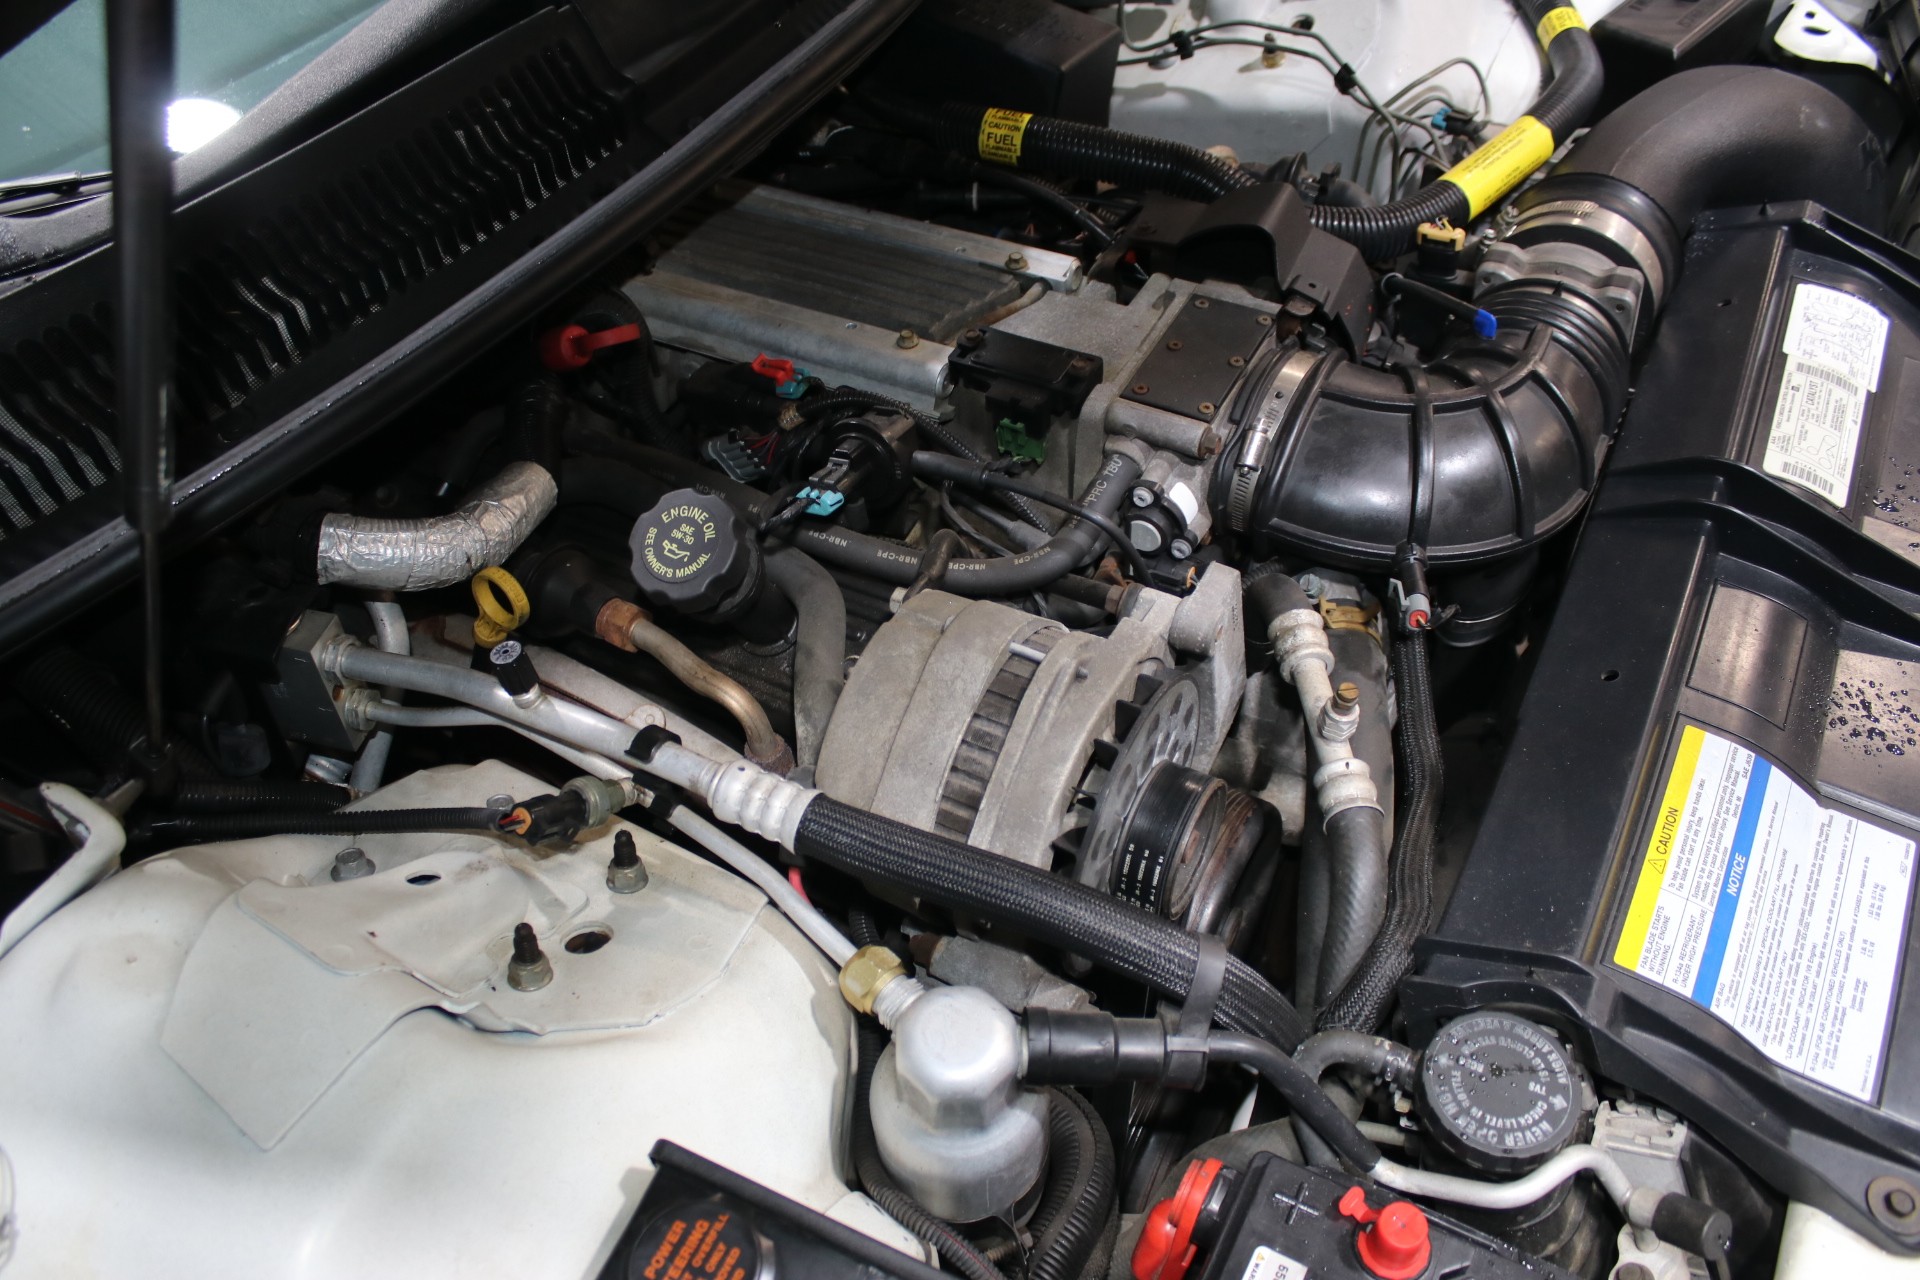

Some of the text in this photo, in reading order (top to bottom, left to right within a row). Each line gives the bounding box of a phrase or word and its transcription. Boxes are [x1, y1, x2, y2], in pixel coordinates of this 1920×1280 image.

[988, 122, 1022, 132] CAUTION
[986, 132, 1017, 146] FUEL
[1806, 380, 1819, 405] CATALYST
[1086, 477, 1108, 504] PRC
[662, 506, 716, 542] ENGINE OIL
[680, 524, 695, 536] SAE
[670, 529, 694, 545] 5W-30
[806, 529, 848, 547] NBR-CPE
[644, 527, 711, 578] SEE OWNER'S MANUAL
[875, 548, 918, 565] NBR-CPE
[1011, 545, 1052, 565] NBR-CPE
[946, 555, 986, 576] NBR-CPE
[1742, 753, 1754, 779] SAE J639
[1698, 777, 1706, 790] clear.
[1731, 769, 1741, 787] Manual.
[1693, 790, 1703, 805] hands
[1726, 787, 1736, 805] Service
[1690, 805, 1698, 817] keep
[1723, 805, 1731, 815] See
[1656, 806, 1679, 855] CAUTION
[1685, 818, 1695, 833] injury,
[1679, 833, 1690, 855] personal
[1680, 867, 1688, 881] blade
[1687, 844, 1695, 856] start
[1696, 815, 1704, 827] time.
[1713, 831, 1724, 853] personal
[1675, 855, 1684, 869] avoid
[1702, 845, 1712, 866] serviced
[1709, 853, 1719, 868] cause
[1671, 870, 1679, 881] help
[1699, 866, 1706, 874] be
[1706, 868, 1714, 880] may
[1708, 846, 1730, 906] General Motors Corporation
[1726, 852, 1747, 896] NOTICE
[1692, 879, 1702, 899] System
[1699, 880, 1711, 902] methods
[1641, 905, 1664, 969] FAN BLADE STARTS
[1745, 987, 1755, 1013] VEHICLE
[1752, 955, 1763, 985] REQUIRES
[1761, 924, 1770, 948] SPECIAL
[1767, 894, 1778, 923] COOLANT
[1776, 848, 1788, 882] PROCEDURE
[1649, 914, 1670, 972] WITHOUT ENGINE
[1673, 914, 1697, 984] R-134a REFRIGERANT
[1680, 908, 1707, 987] UNDER HIGH PRESSURE
[1657, 942, 1671, 976] RUNNING.
[1774, 967, 1784, 996] COOLANT
[1781, 949, 1789, 966] ONLY
[1798, 975, 1810, 1008] INDICATOR
[1808, 941, 1818, 963] Engine)
[1718, 982, 1726, 996] BAG
[1815, 1034, 1823, 1050] (FOR
[1821, 978, 1835, 1021] CONDITIONED
[1831, 948, 1842, 977] VEHICLES
[1837, 930, 1846, 948] ONLY)
[1485, 1112, 1518, 1128] LEVEL
[1520, 1100, 1548, 1127] CHECK
[1504, 1120, 1553, 1147] NEVER
[643, 1219, 687, 1280] POWER
[706, 1242, 726, 1272] ONLY
